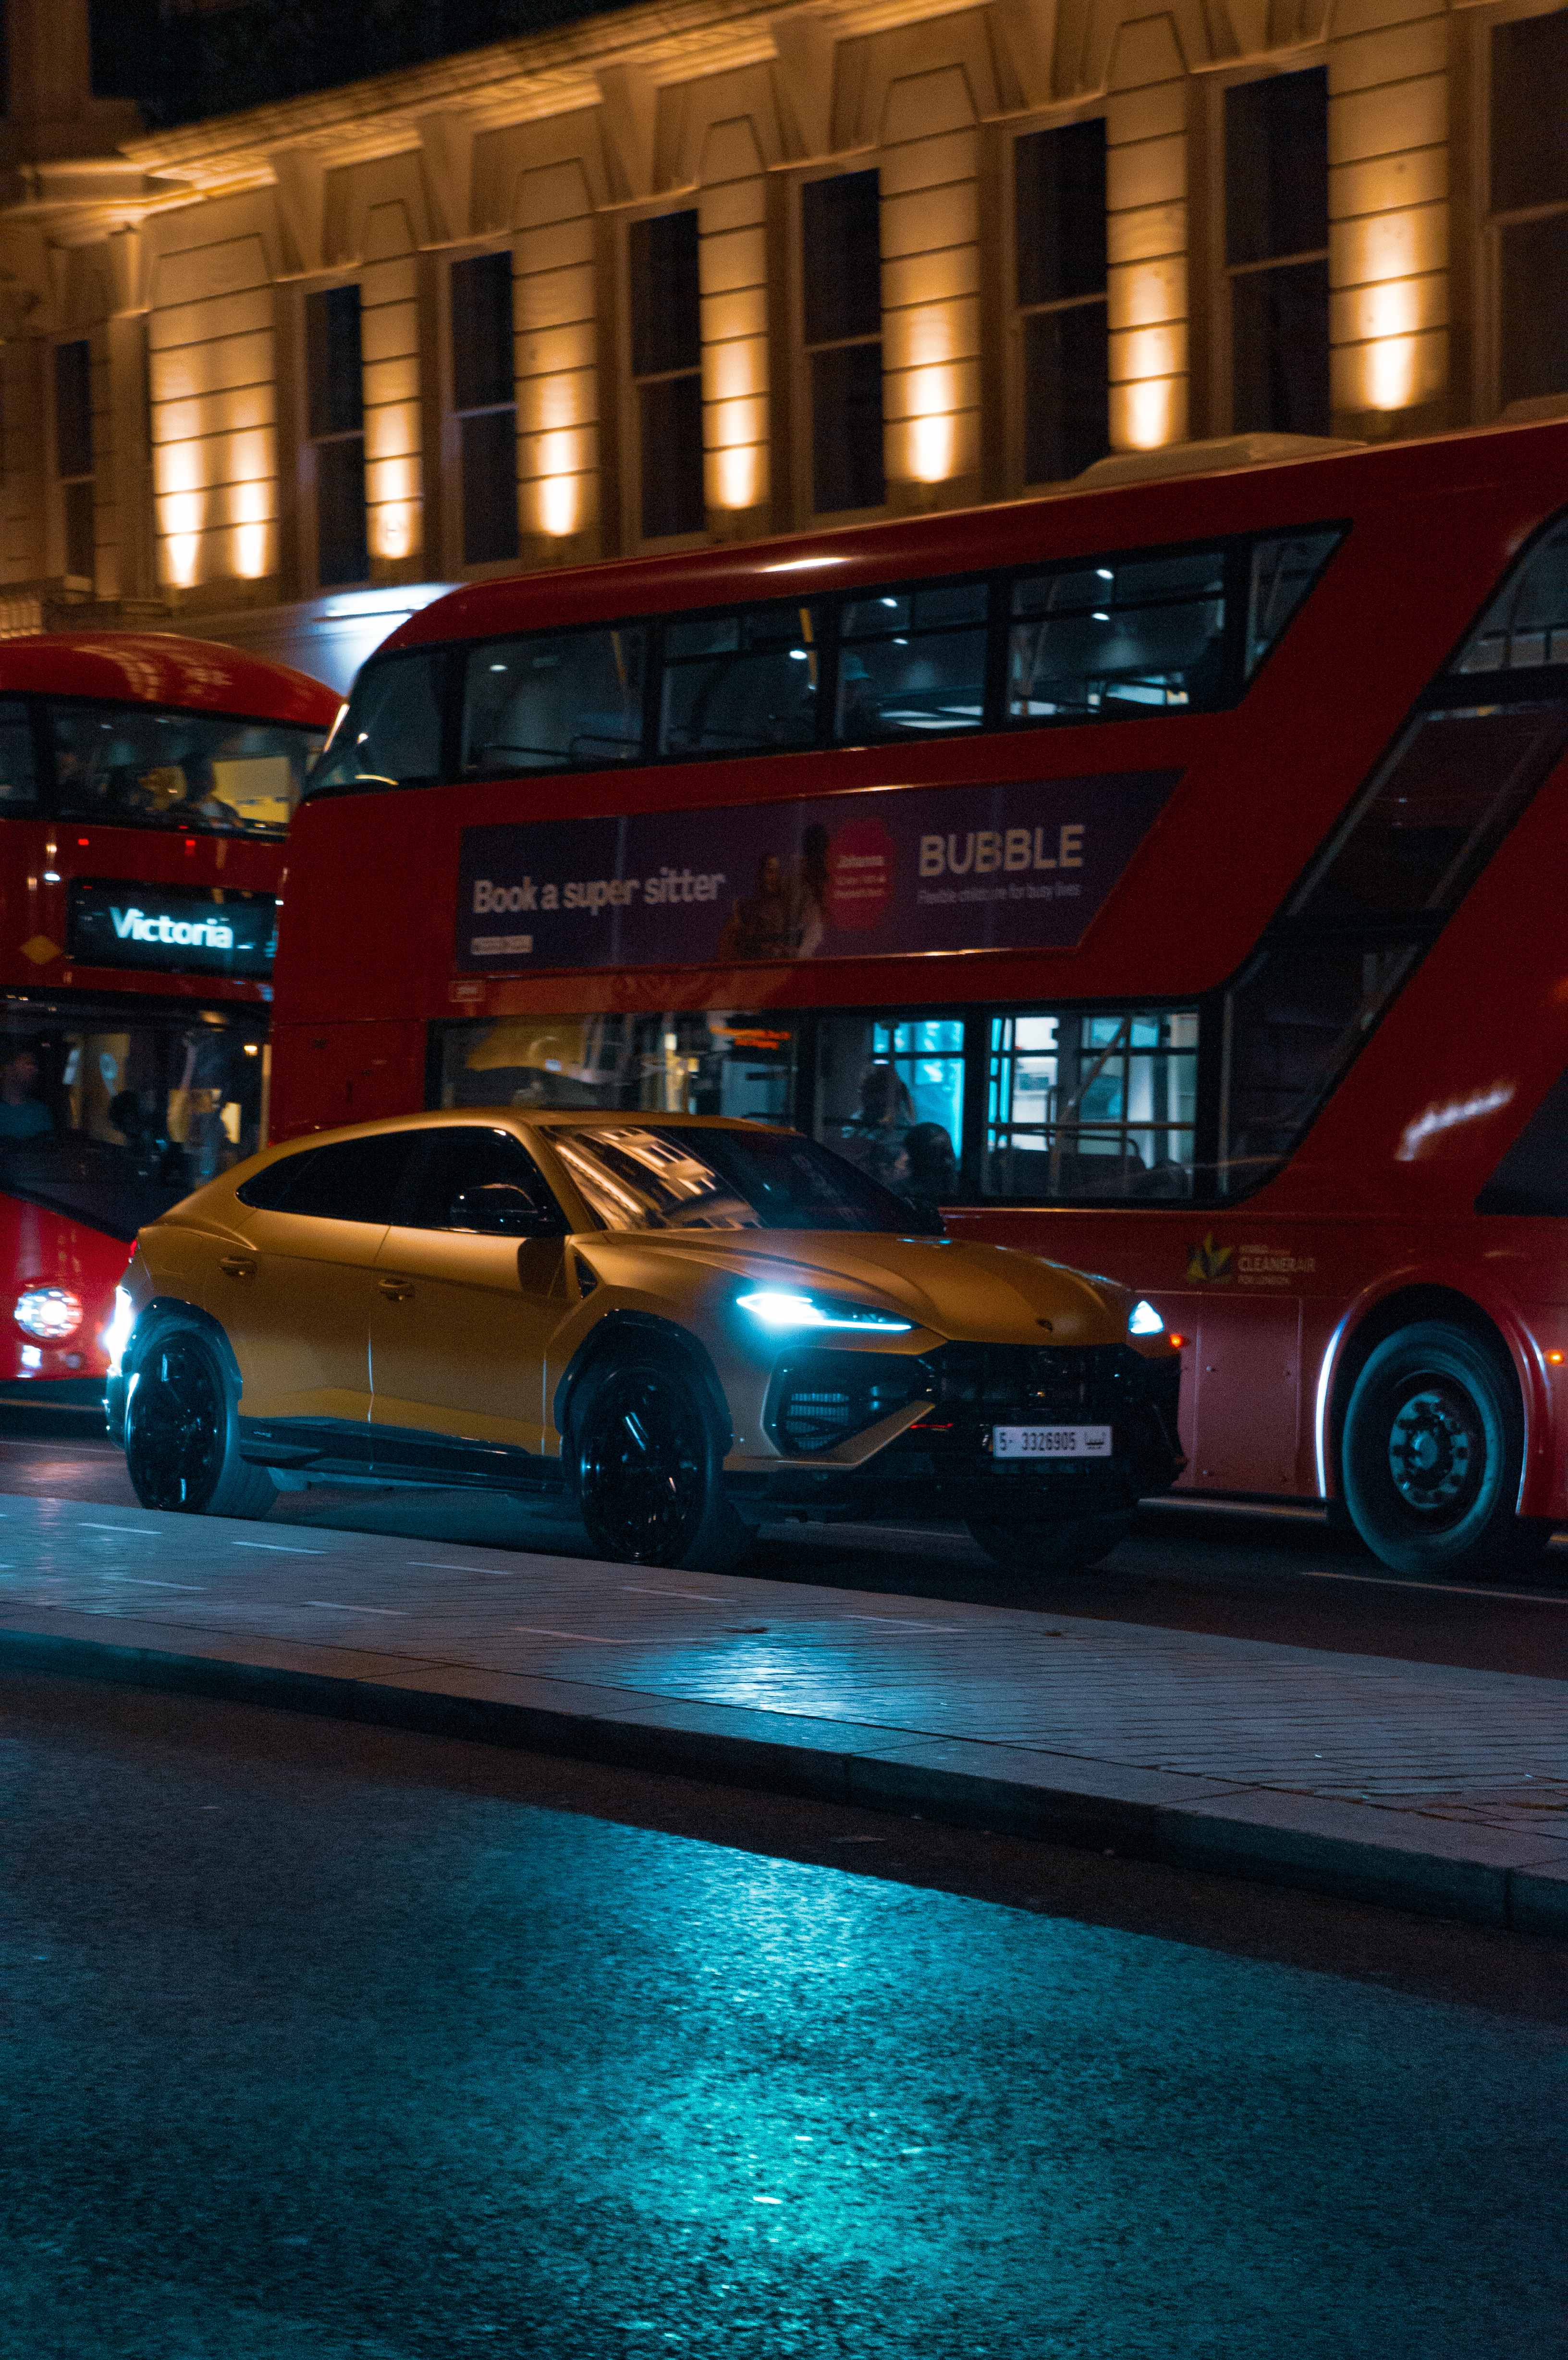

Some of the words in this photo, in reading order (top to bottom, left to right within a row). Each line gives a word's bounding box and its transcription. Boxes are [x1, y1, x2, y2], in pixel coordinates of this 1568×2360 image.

[921, 824, 1085, 876] BUBBLE
[473, 876, 539, 914] Book
[541, 885, 560, 911] a
[563, 876, 639, 916] super
[644, 866, 725, 904] sitter
[109, 905, 234, 949] Victoria
[1237, 1255, 1297, 1272] CLEANER
[1022, 1432, 1076, 1451] 3326905
